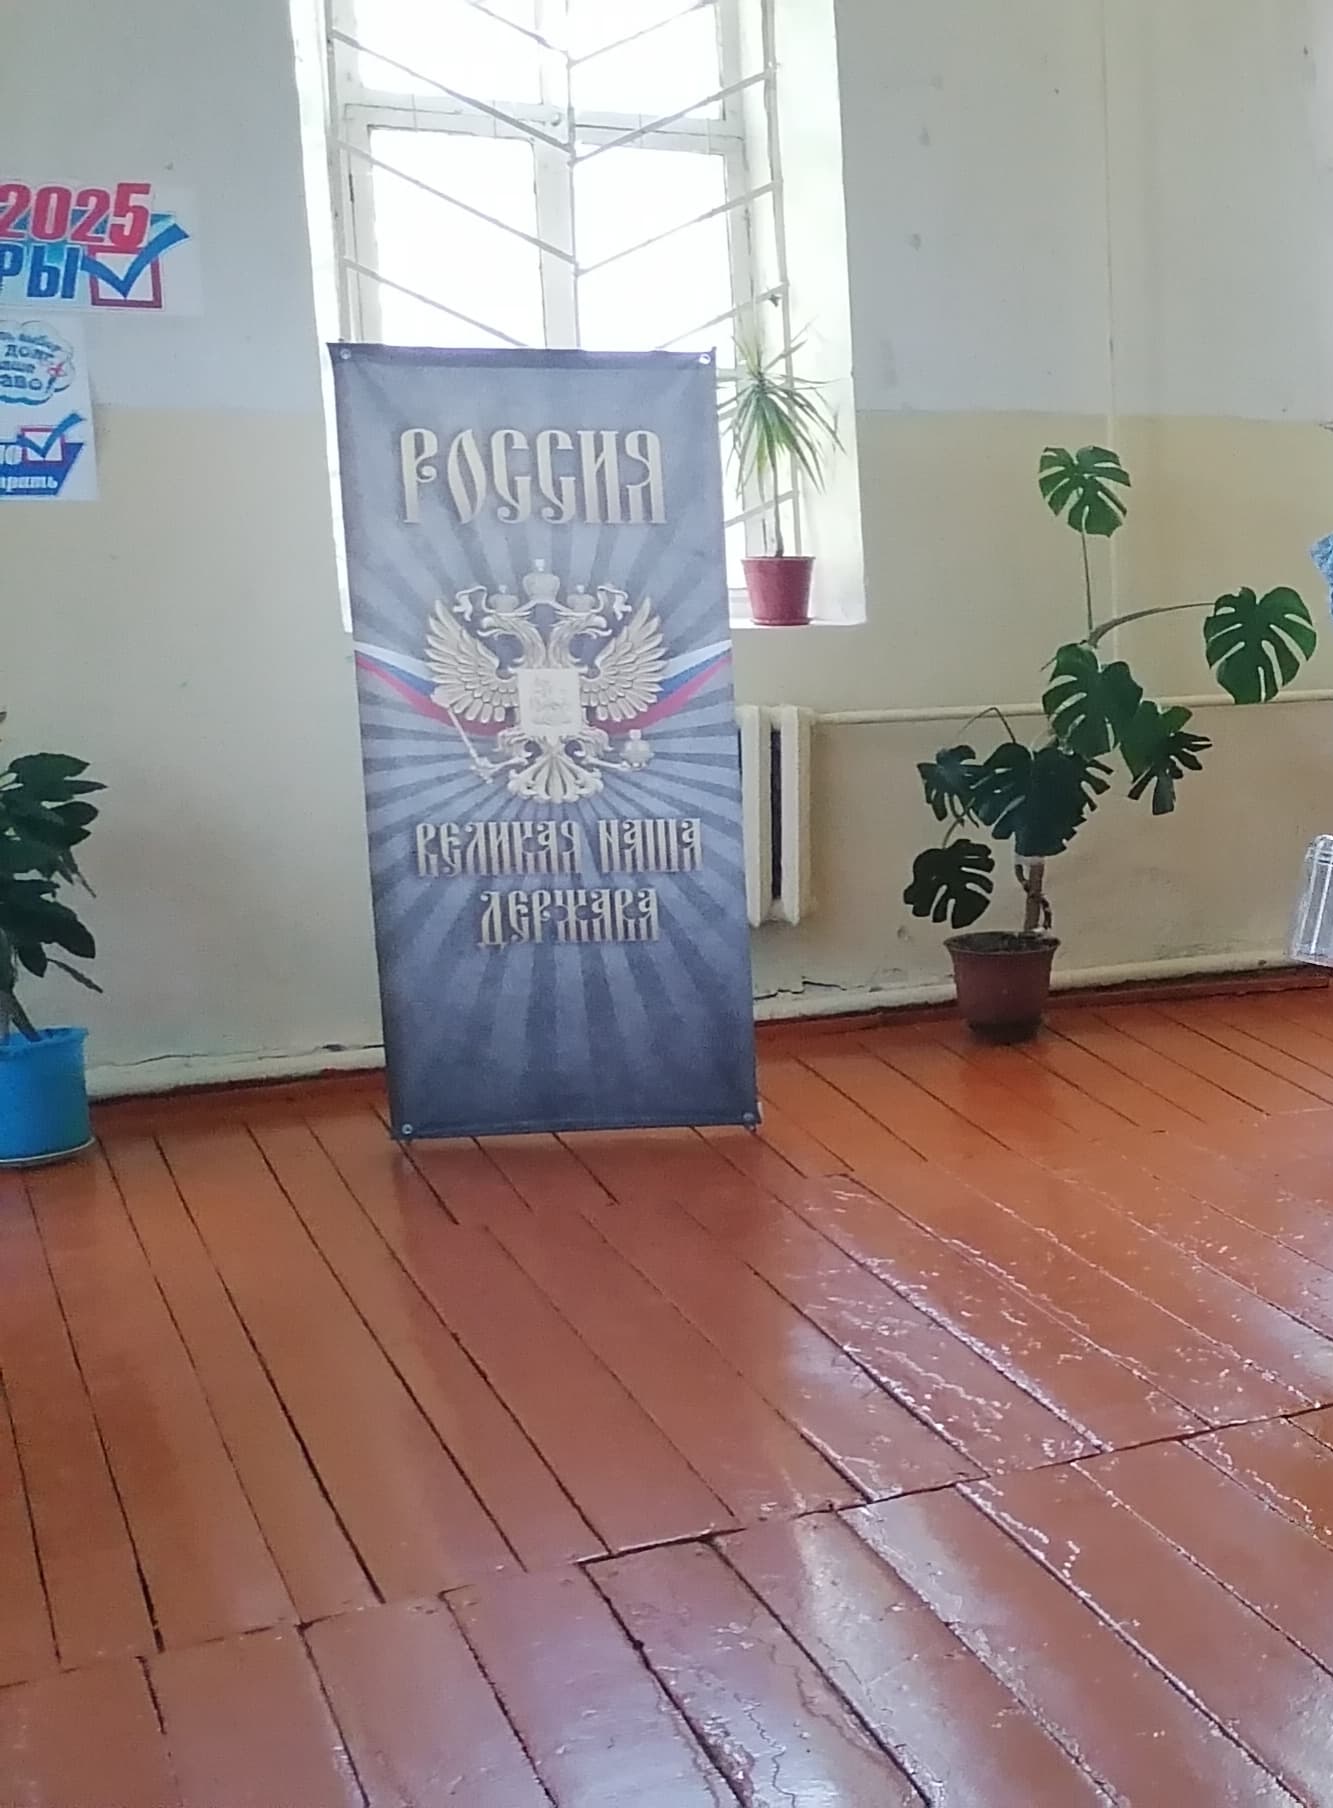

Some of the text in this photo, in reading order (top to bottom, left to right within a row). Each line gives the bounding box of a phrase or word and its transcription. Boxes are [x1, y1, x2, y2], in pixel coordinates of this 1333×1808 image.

[0, 183, 151, 248] 2025
[400, 428, 667, 525] РОССИЯ
[416, 818, 702, 877] ВЕЛИКАЯ НАША
[479, 887, 658, 949] ДЕРЖАВА
